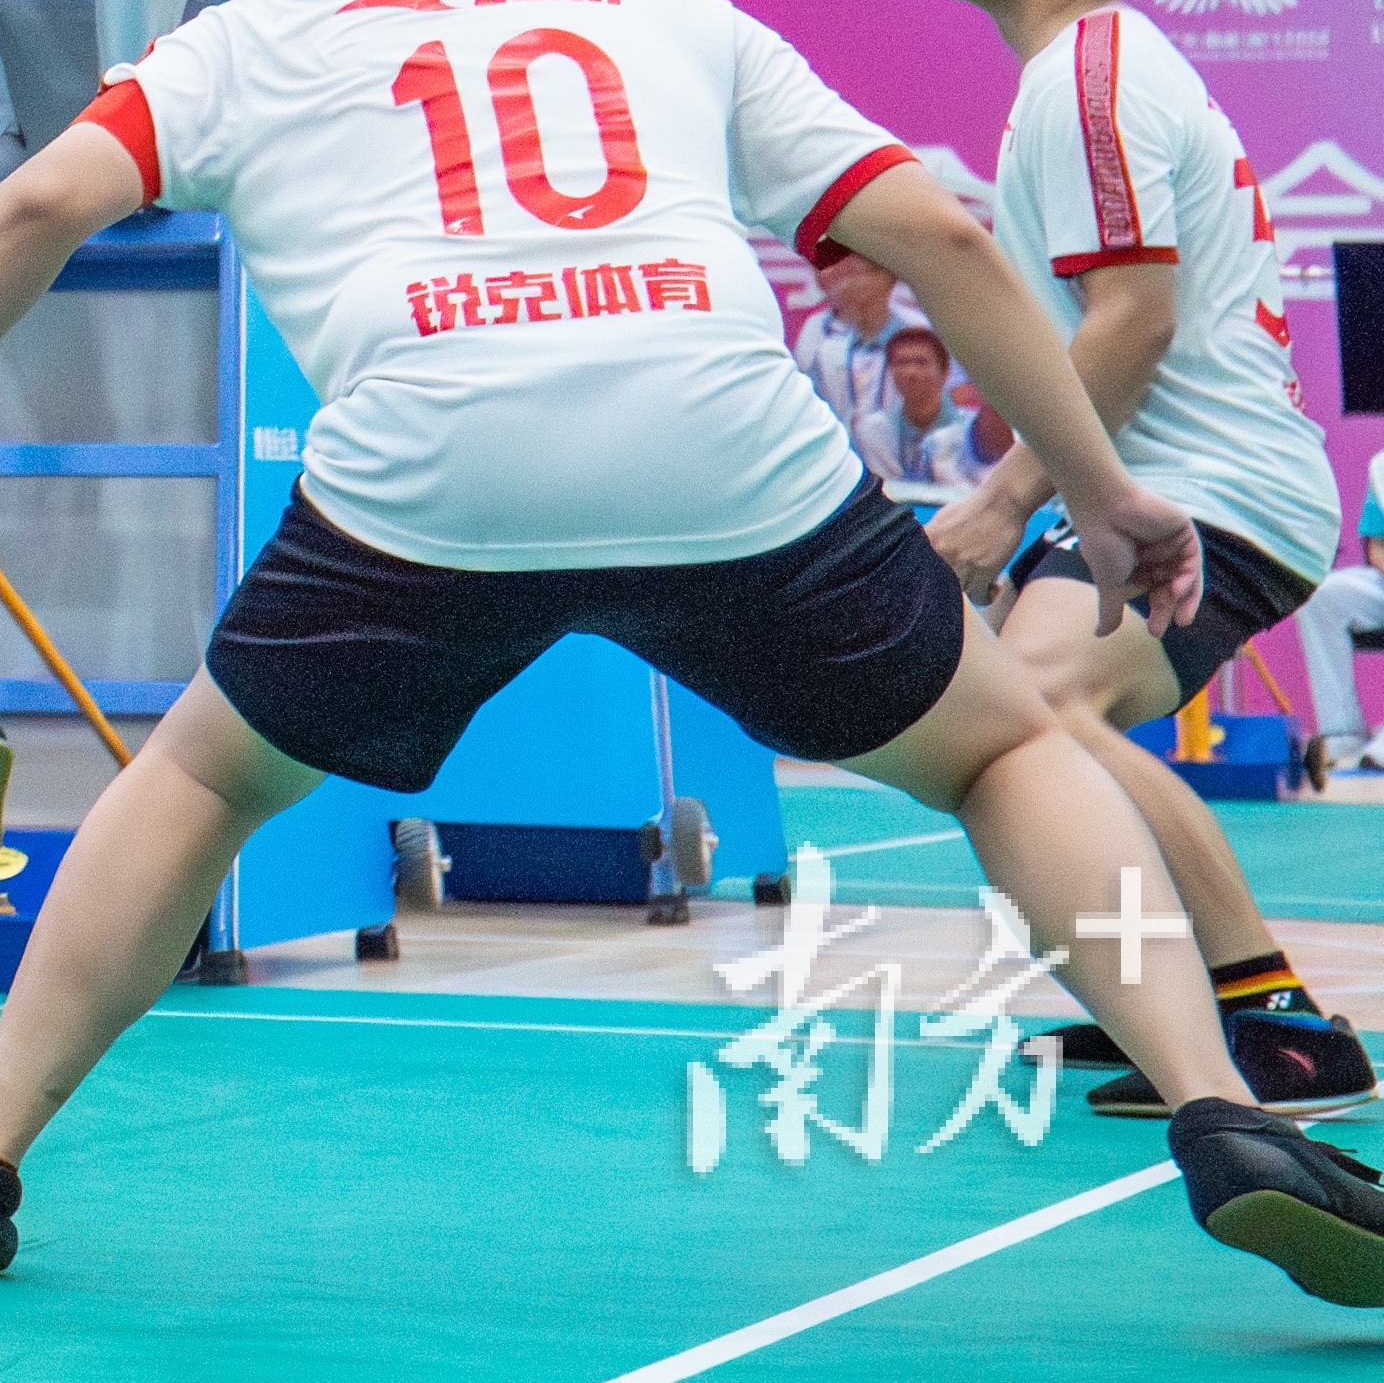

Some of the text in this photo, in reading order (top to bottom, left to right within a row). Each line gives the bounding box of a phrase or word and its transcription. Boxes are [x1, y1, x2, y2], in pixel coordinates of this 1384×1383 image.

[391, 26, 648, 237] 10
[404, 257, 713, 338] 锐克体育
